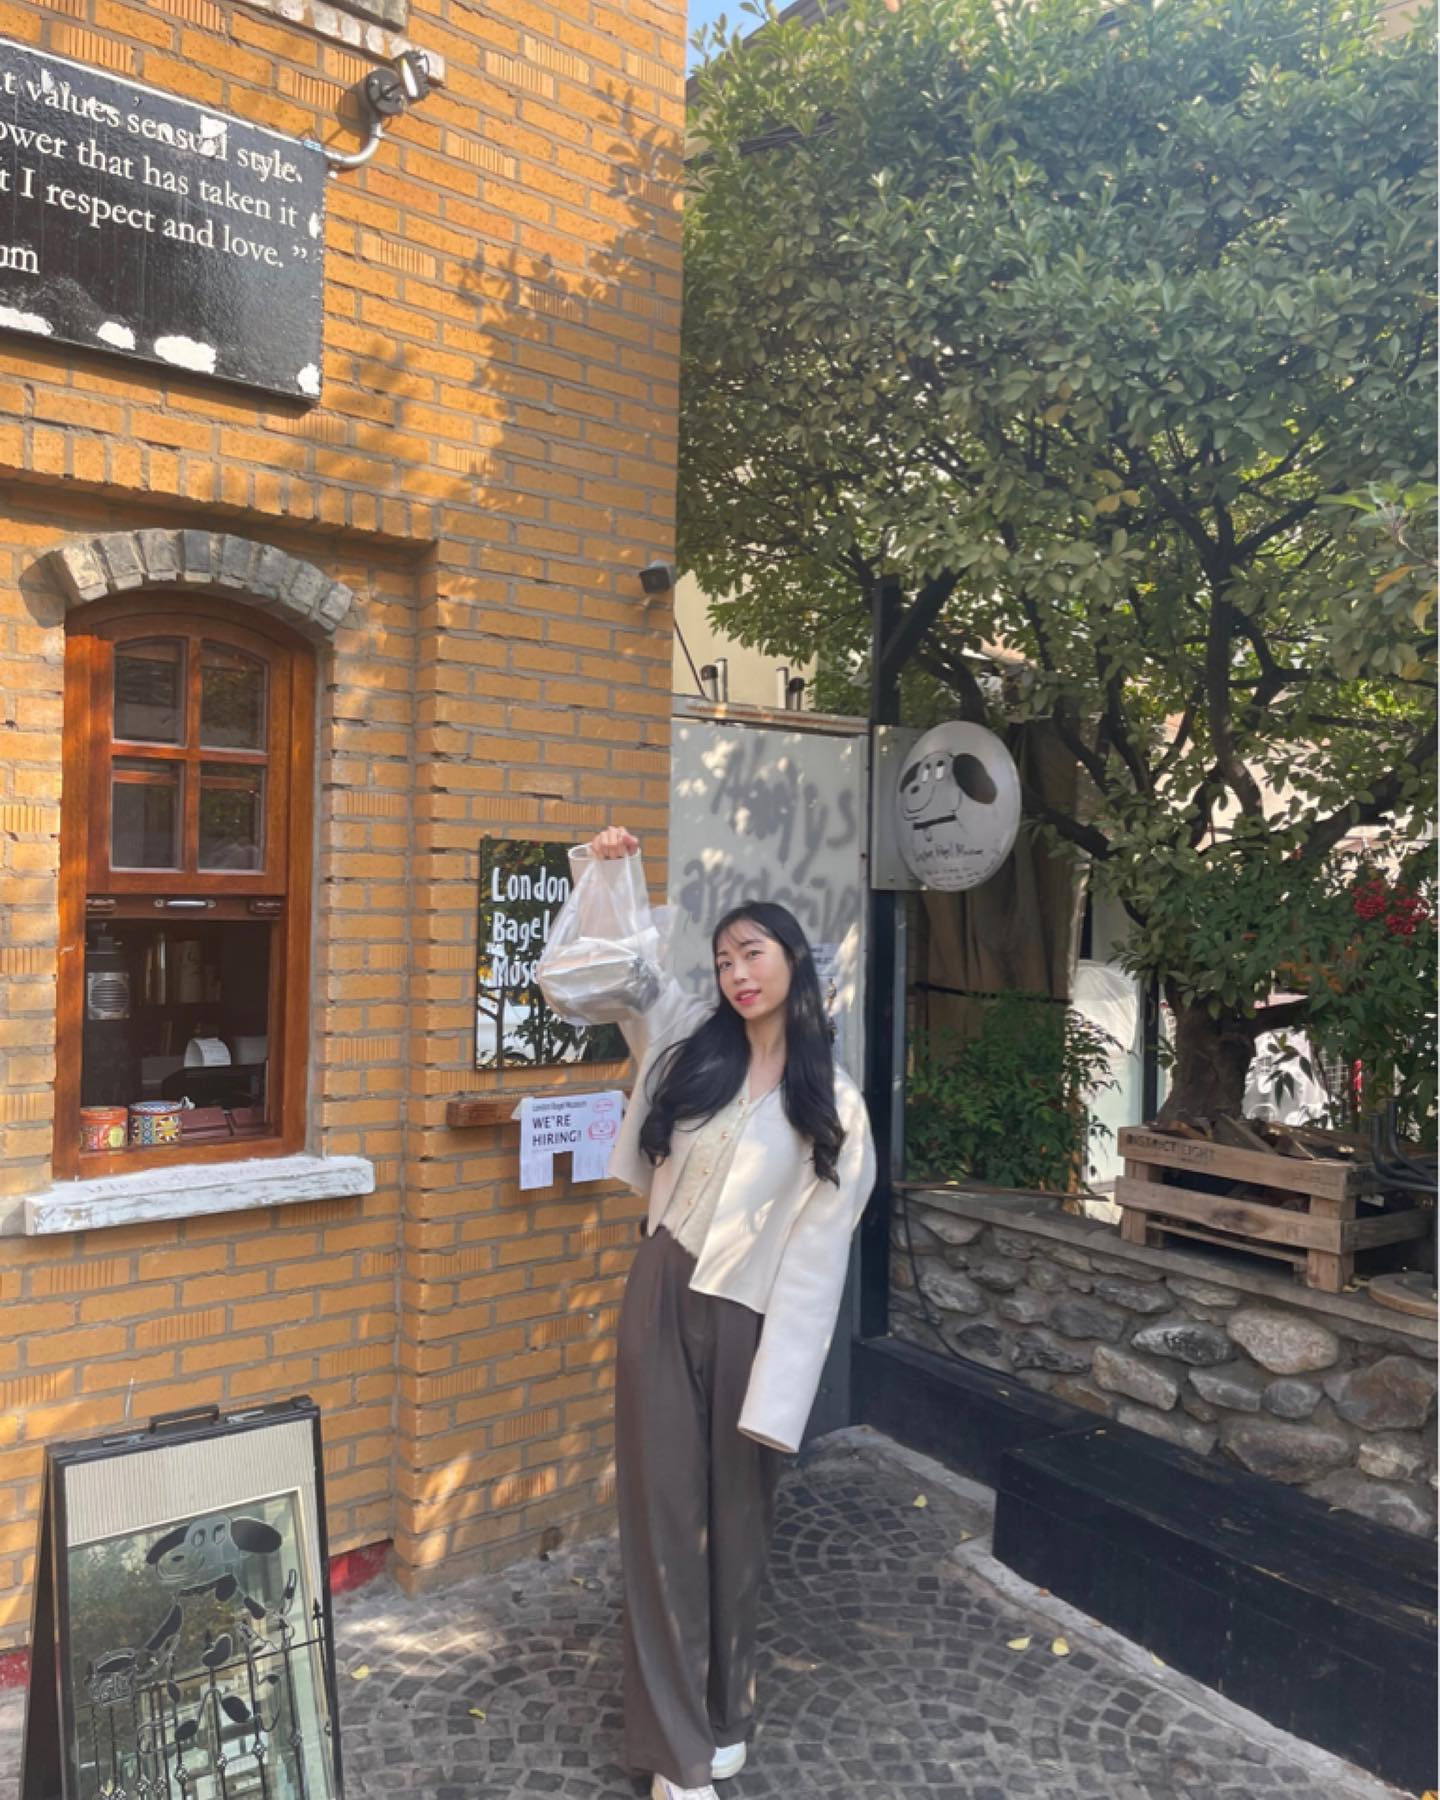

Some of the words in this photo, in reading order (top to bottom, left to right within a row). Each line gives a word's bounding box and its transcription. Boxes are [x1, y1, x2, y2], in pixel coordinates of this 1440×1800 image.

[26, 79, 120, 128] values
[77, 138, 134, 180] that
[143, 155, 189, 195] has
[199, 180, 272, 221] taken
[279, 197, 298, 228] it
[20, 166, 36, 198] I
[46, 182, 156, 233] respect
[162, 218, 215, 249] and
[223, 224, 284, 268] love.
[492, 866, 569, 903] London
[493, 909, 550, 952] Bagel
[532, 1114, 571, 1128] WE'RE
[532, 1129, 582, 1146] HIRING!
